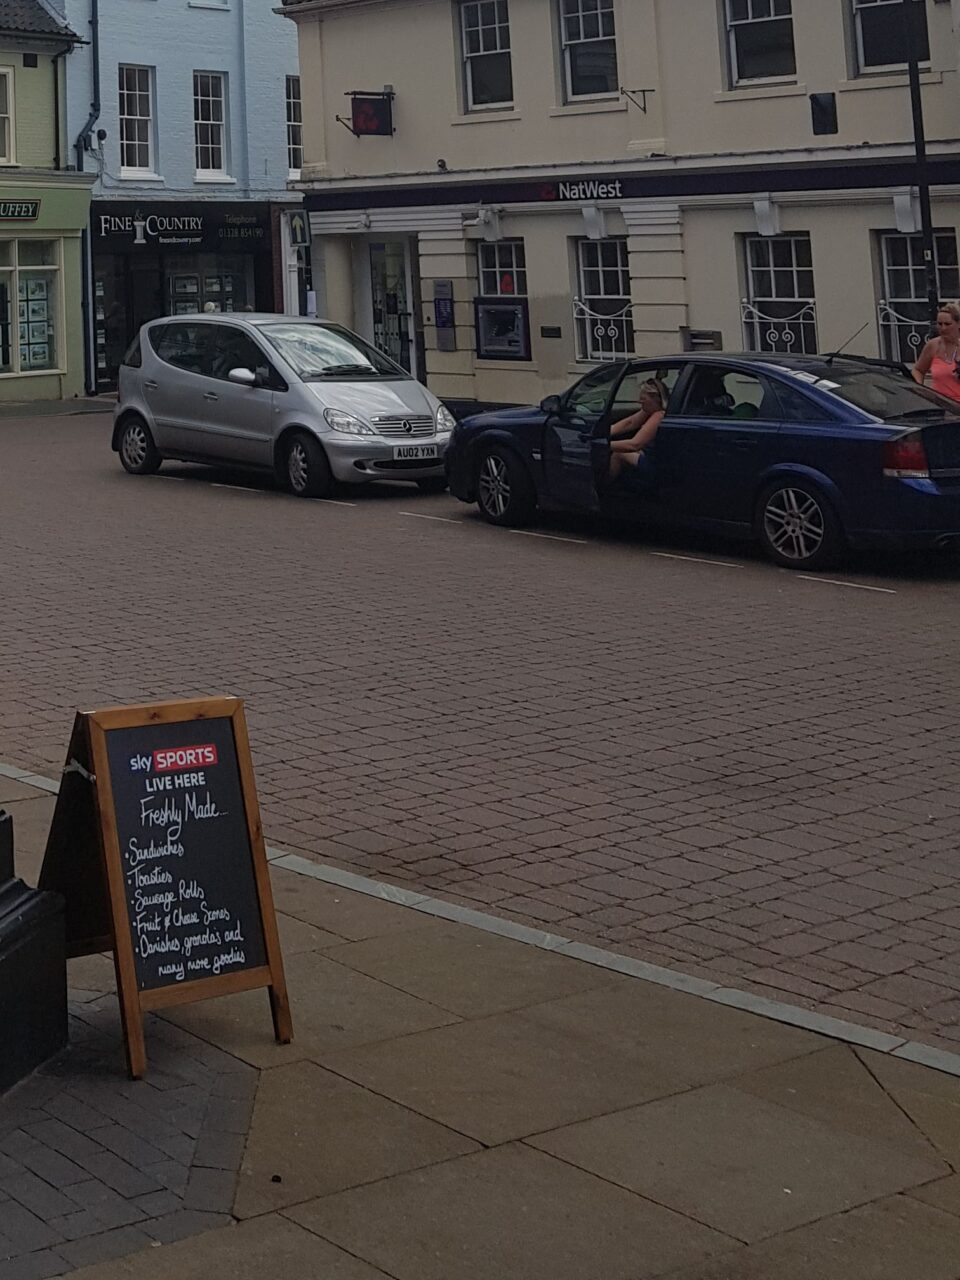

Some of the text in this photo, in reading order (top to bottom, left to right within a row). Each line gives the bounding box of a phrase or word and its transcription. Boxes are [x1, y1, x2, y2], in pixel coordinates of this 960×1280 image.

[558, 180, 623, 200] NatWest
[99, 215, 133, 237] FINE
[146, 214, 204, 236] COUNTRY
[397, 446, 435, 458] AU02 YXN
[130, 748, 214, 772] sky SPORTS
[145, 772, 206, 792] LIVE HERE
[140, 795, 182, 841] Freshly
[135, 879, 205, 912] Sausage Rolls
[136, 911, 161, 936] Fruit
[172, 908, 199, 927] Cheese
[200, 901, 231, 925] Scones
[224, 919, 244, 942] and
[158, 947, 245, 981] many more goodies
